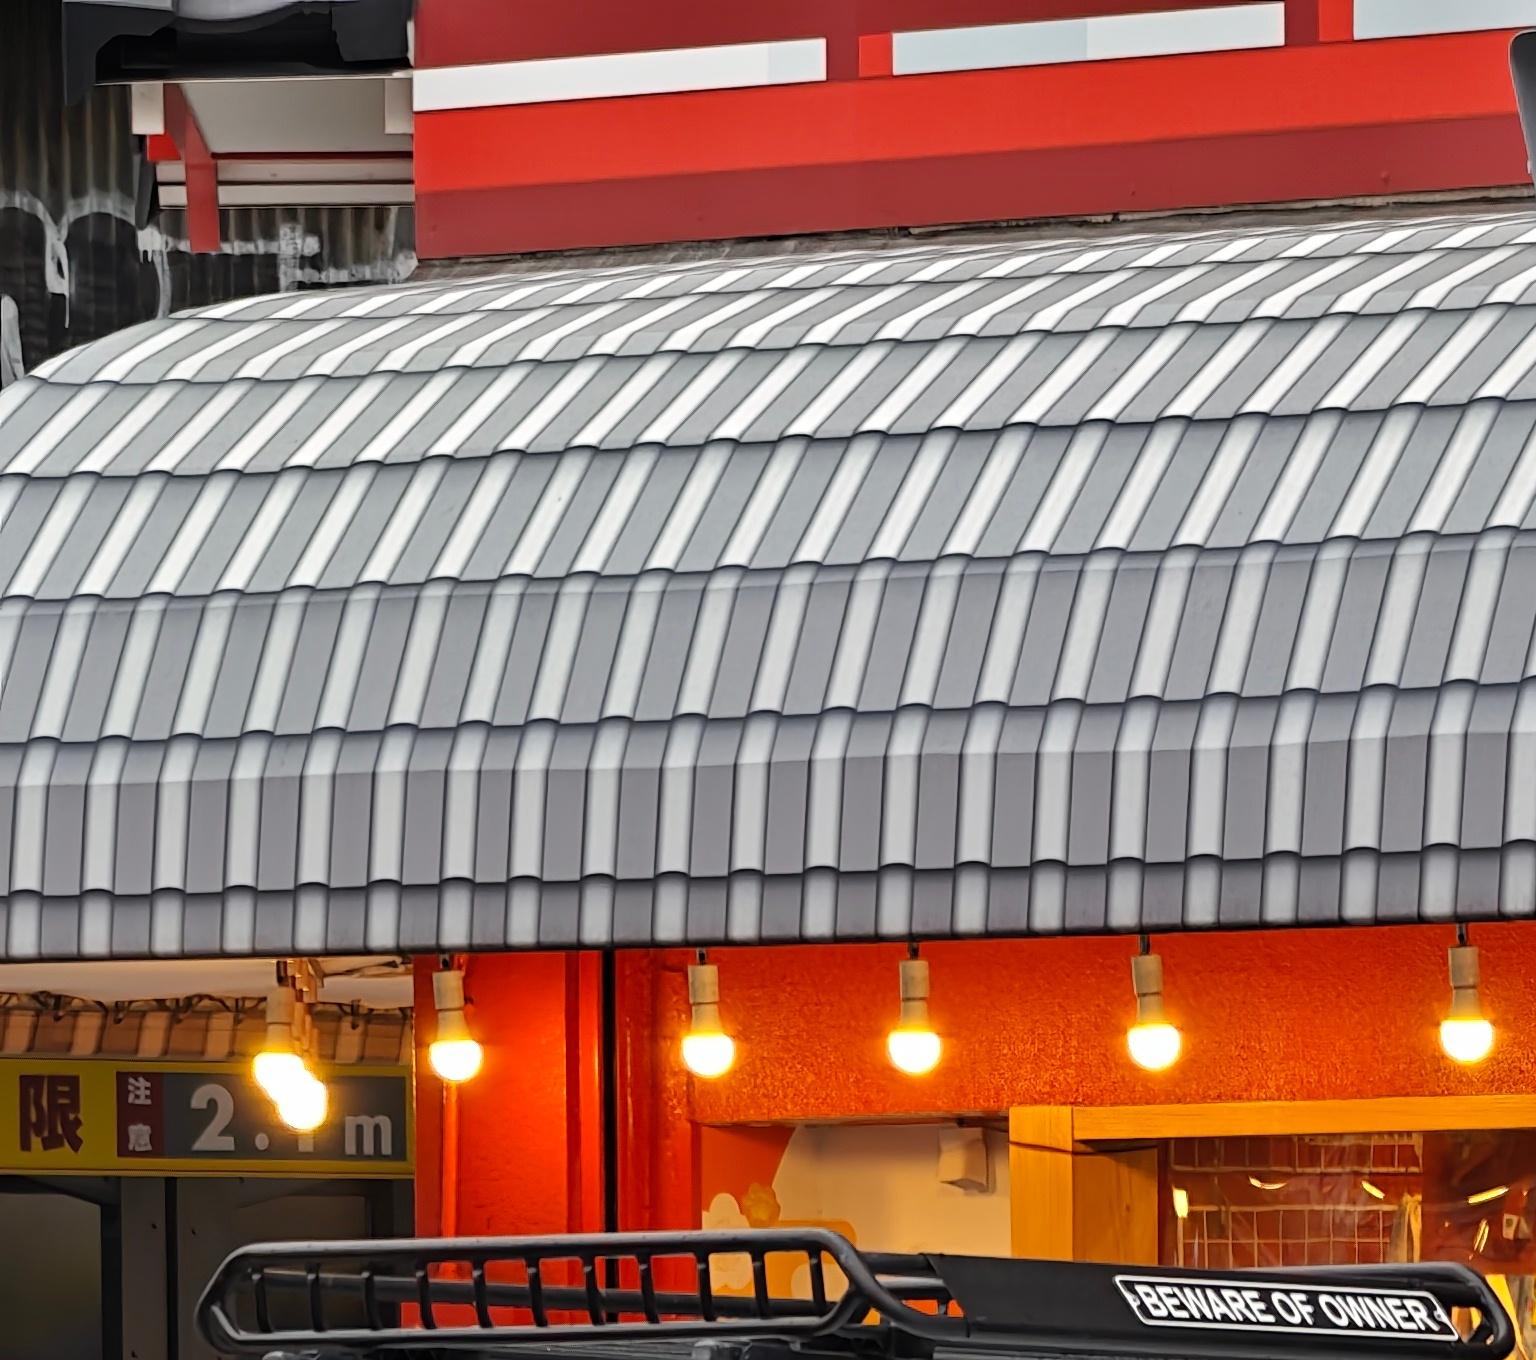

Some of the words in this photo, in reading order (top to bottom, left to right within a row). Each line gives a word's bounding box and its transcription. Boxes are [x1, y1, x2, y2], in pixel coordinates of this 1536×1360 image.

[18, 1075, 84, 1154] 限
[1135, 1284, 1276, 1323] BEWARE
[1271, 1292, 1316, 1326] OF
[1318, 1294, 1441, 1331] OWNER
